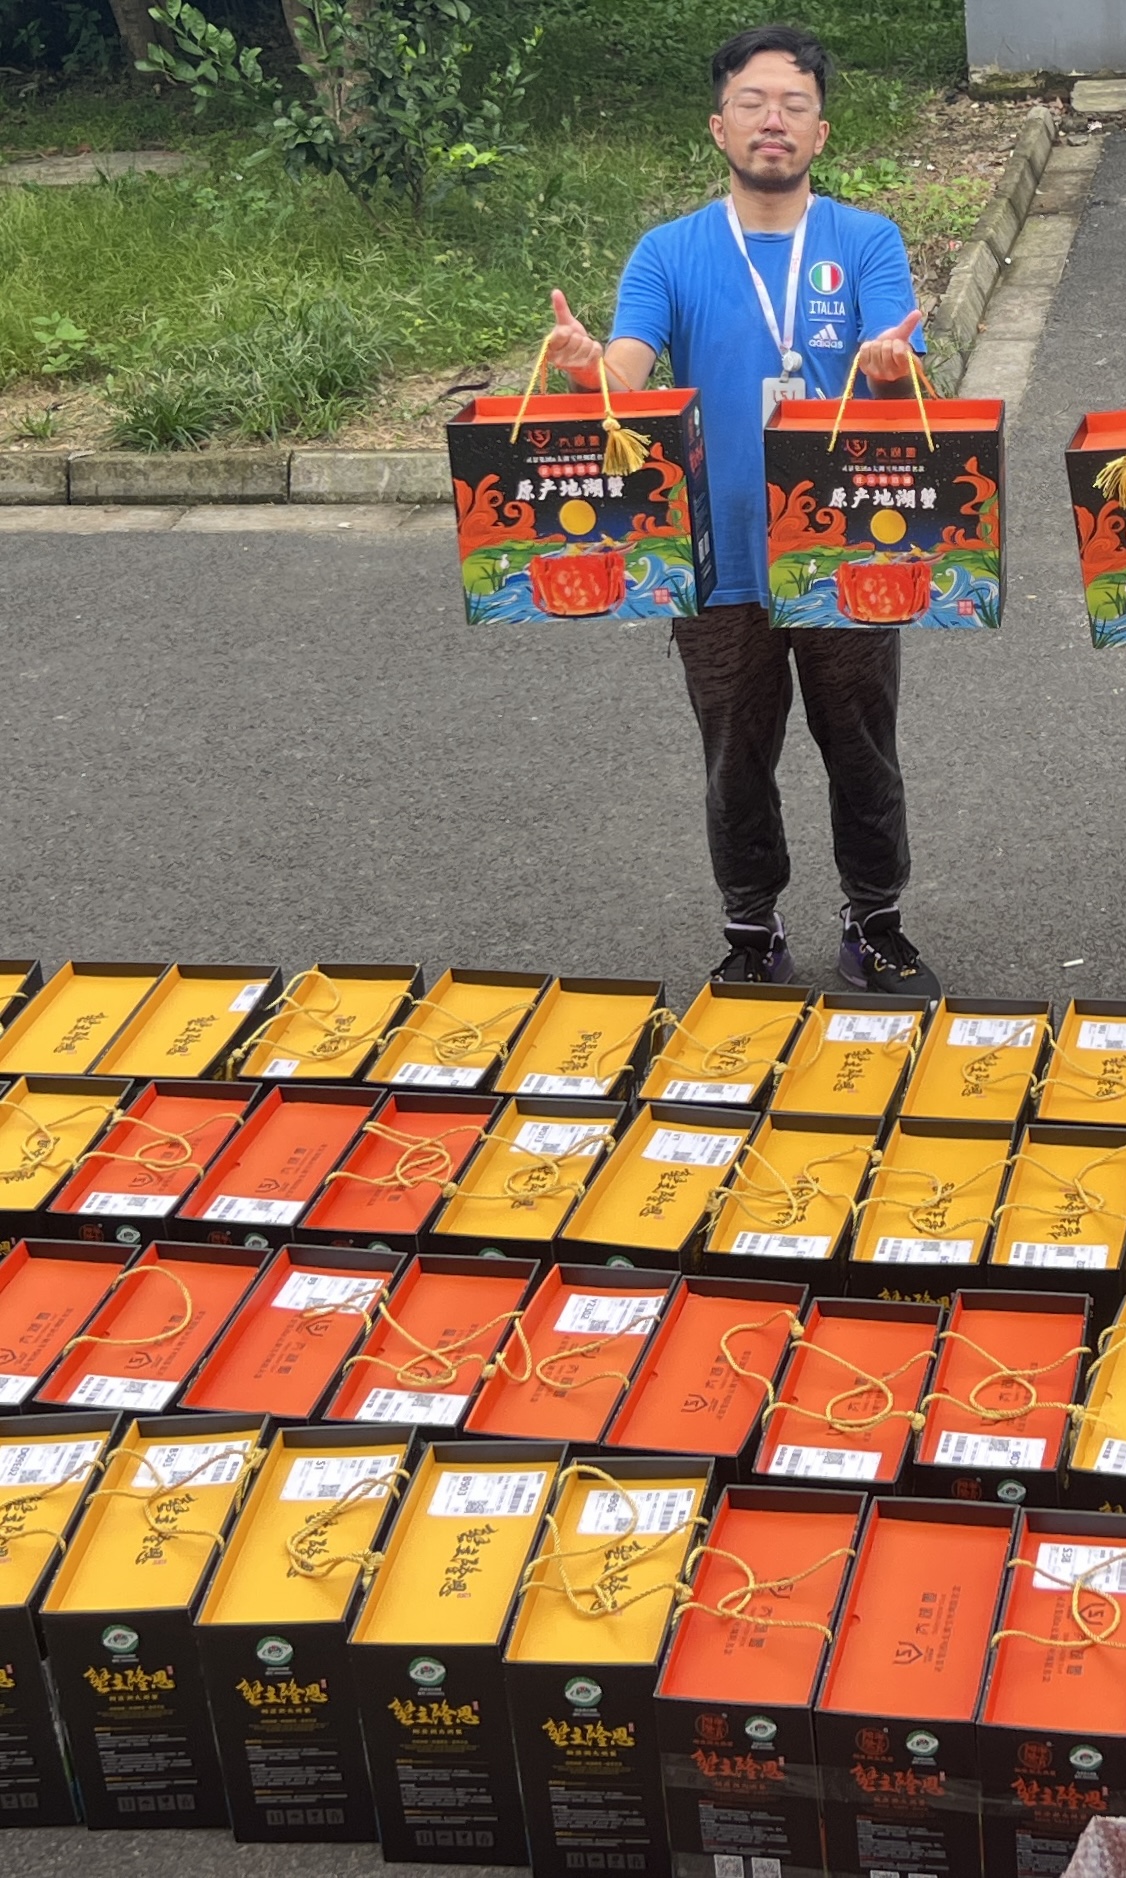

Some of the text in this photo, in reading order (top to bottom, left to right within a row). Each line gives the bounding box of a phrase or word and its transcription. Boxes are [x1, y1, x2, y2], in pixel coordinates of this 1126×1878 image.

[808, 300, 846, 316] ITALIA
[808, 339, 844, 349] adidas
[516, 476, 625, 501] 原产地湖蟹
[828, 486, 937, 509] 原产地湖蟹
[440, 1525, 498, 1597] 蟹主隆恩
[83, 1664, 176, 1693] 蟹主隆恩
[235, 1678, 329, 1706] 蟹主隆恩
[387, 1697, 481, 1726] 蟹主隆恩
[541, 1717, 636, 1747] 蟹主隆恩
[690, 1748, 787, 1780] 蟹主隆恩
[849, 1762, 945, 1796] 蟹主隆恩
[1010, 1776, 1108, 1811] 蟹主隆恩
